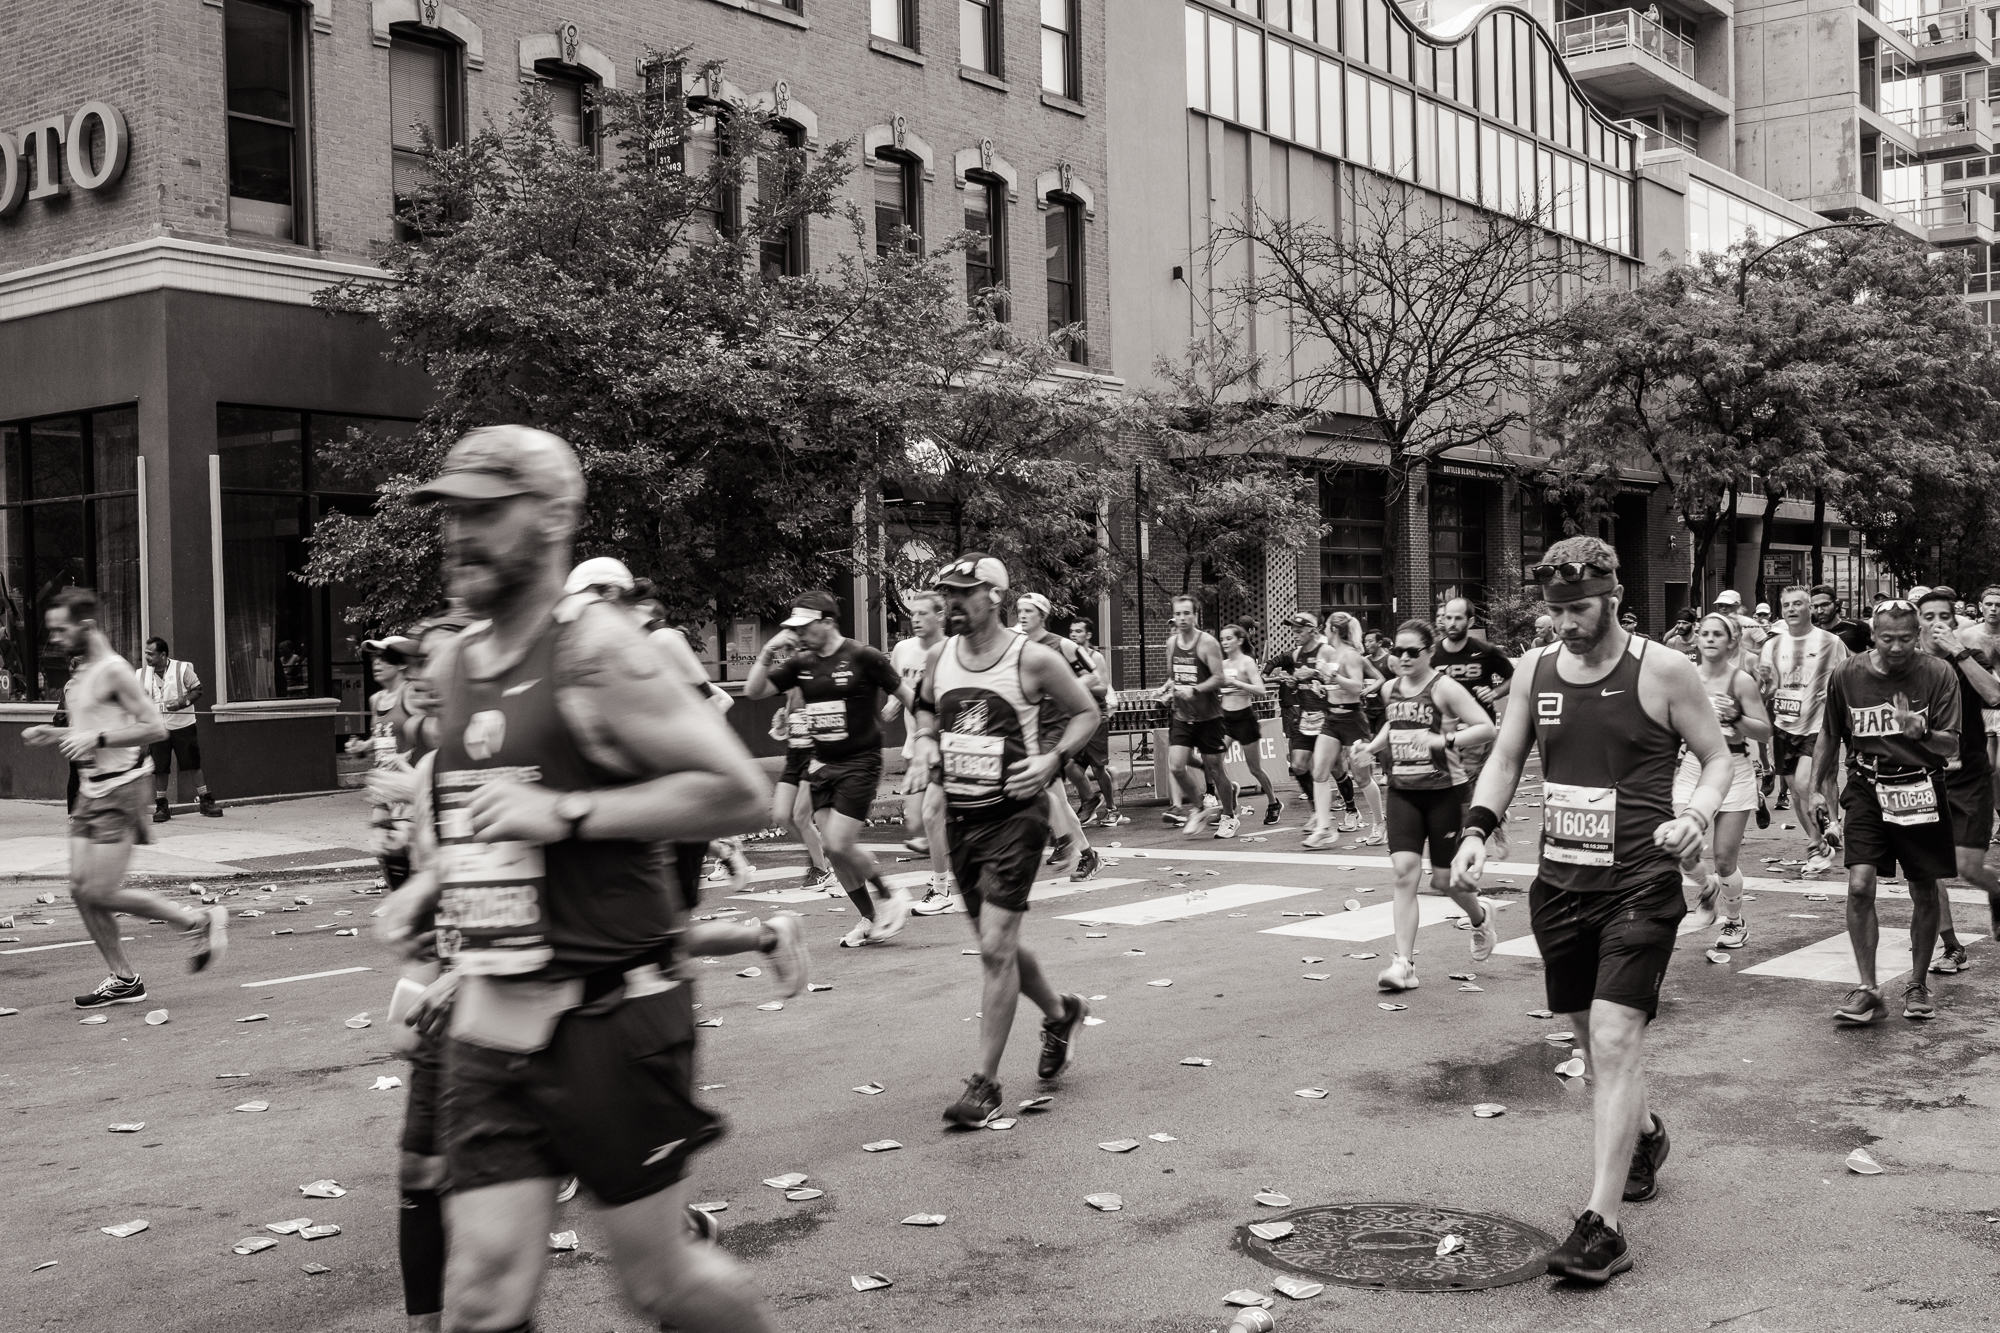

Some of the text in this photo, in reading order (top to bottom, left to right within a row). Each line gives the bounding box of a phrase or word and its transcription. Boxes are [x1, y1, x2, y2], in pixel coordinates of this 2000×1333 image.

[655, 126, 673, 137] SPACE
[660, 156, 670, 164] 312
[1539, 717, 1562, 726] Abbott
[1892, 790, 1935, 809] 10648
[1554, 810, 1611, 839] 16034
